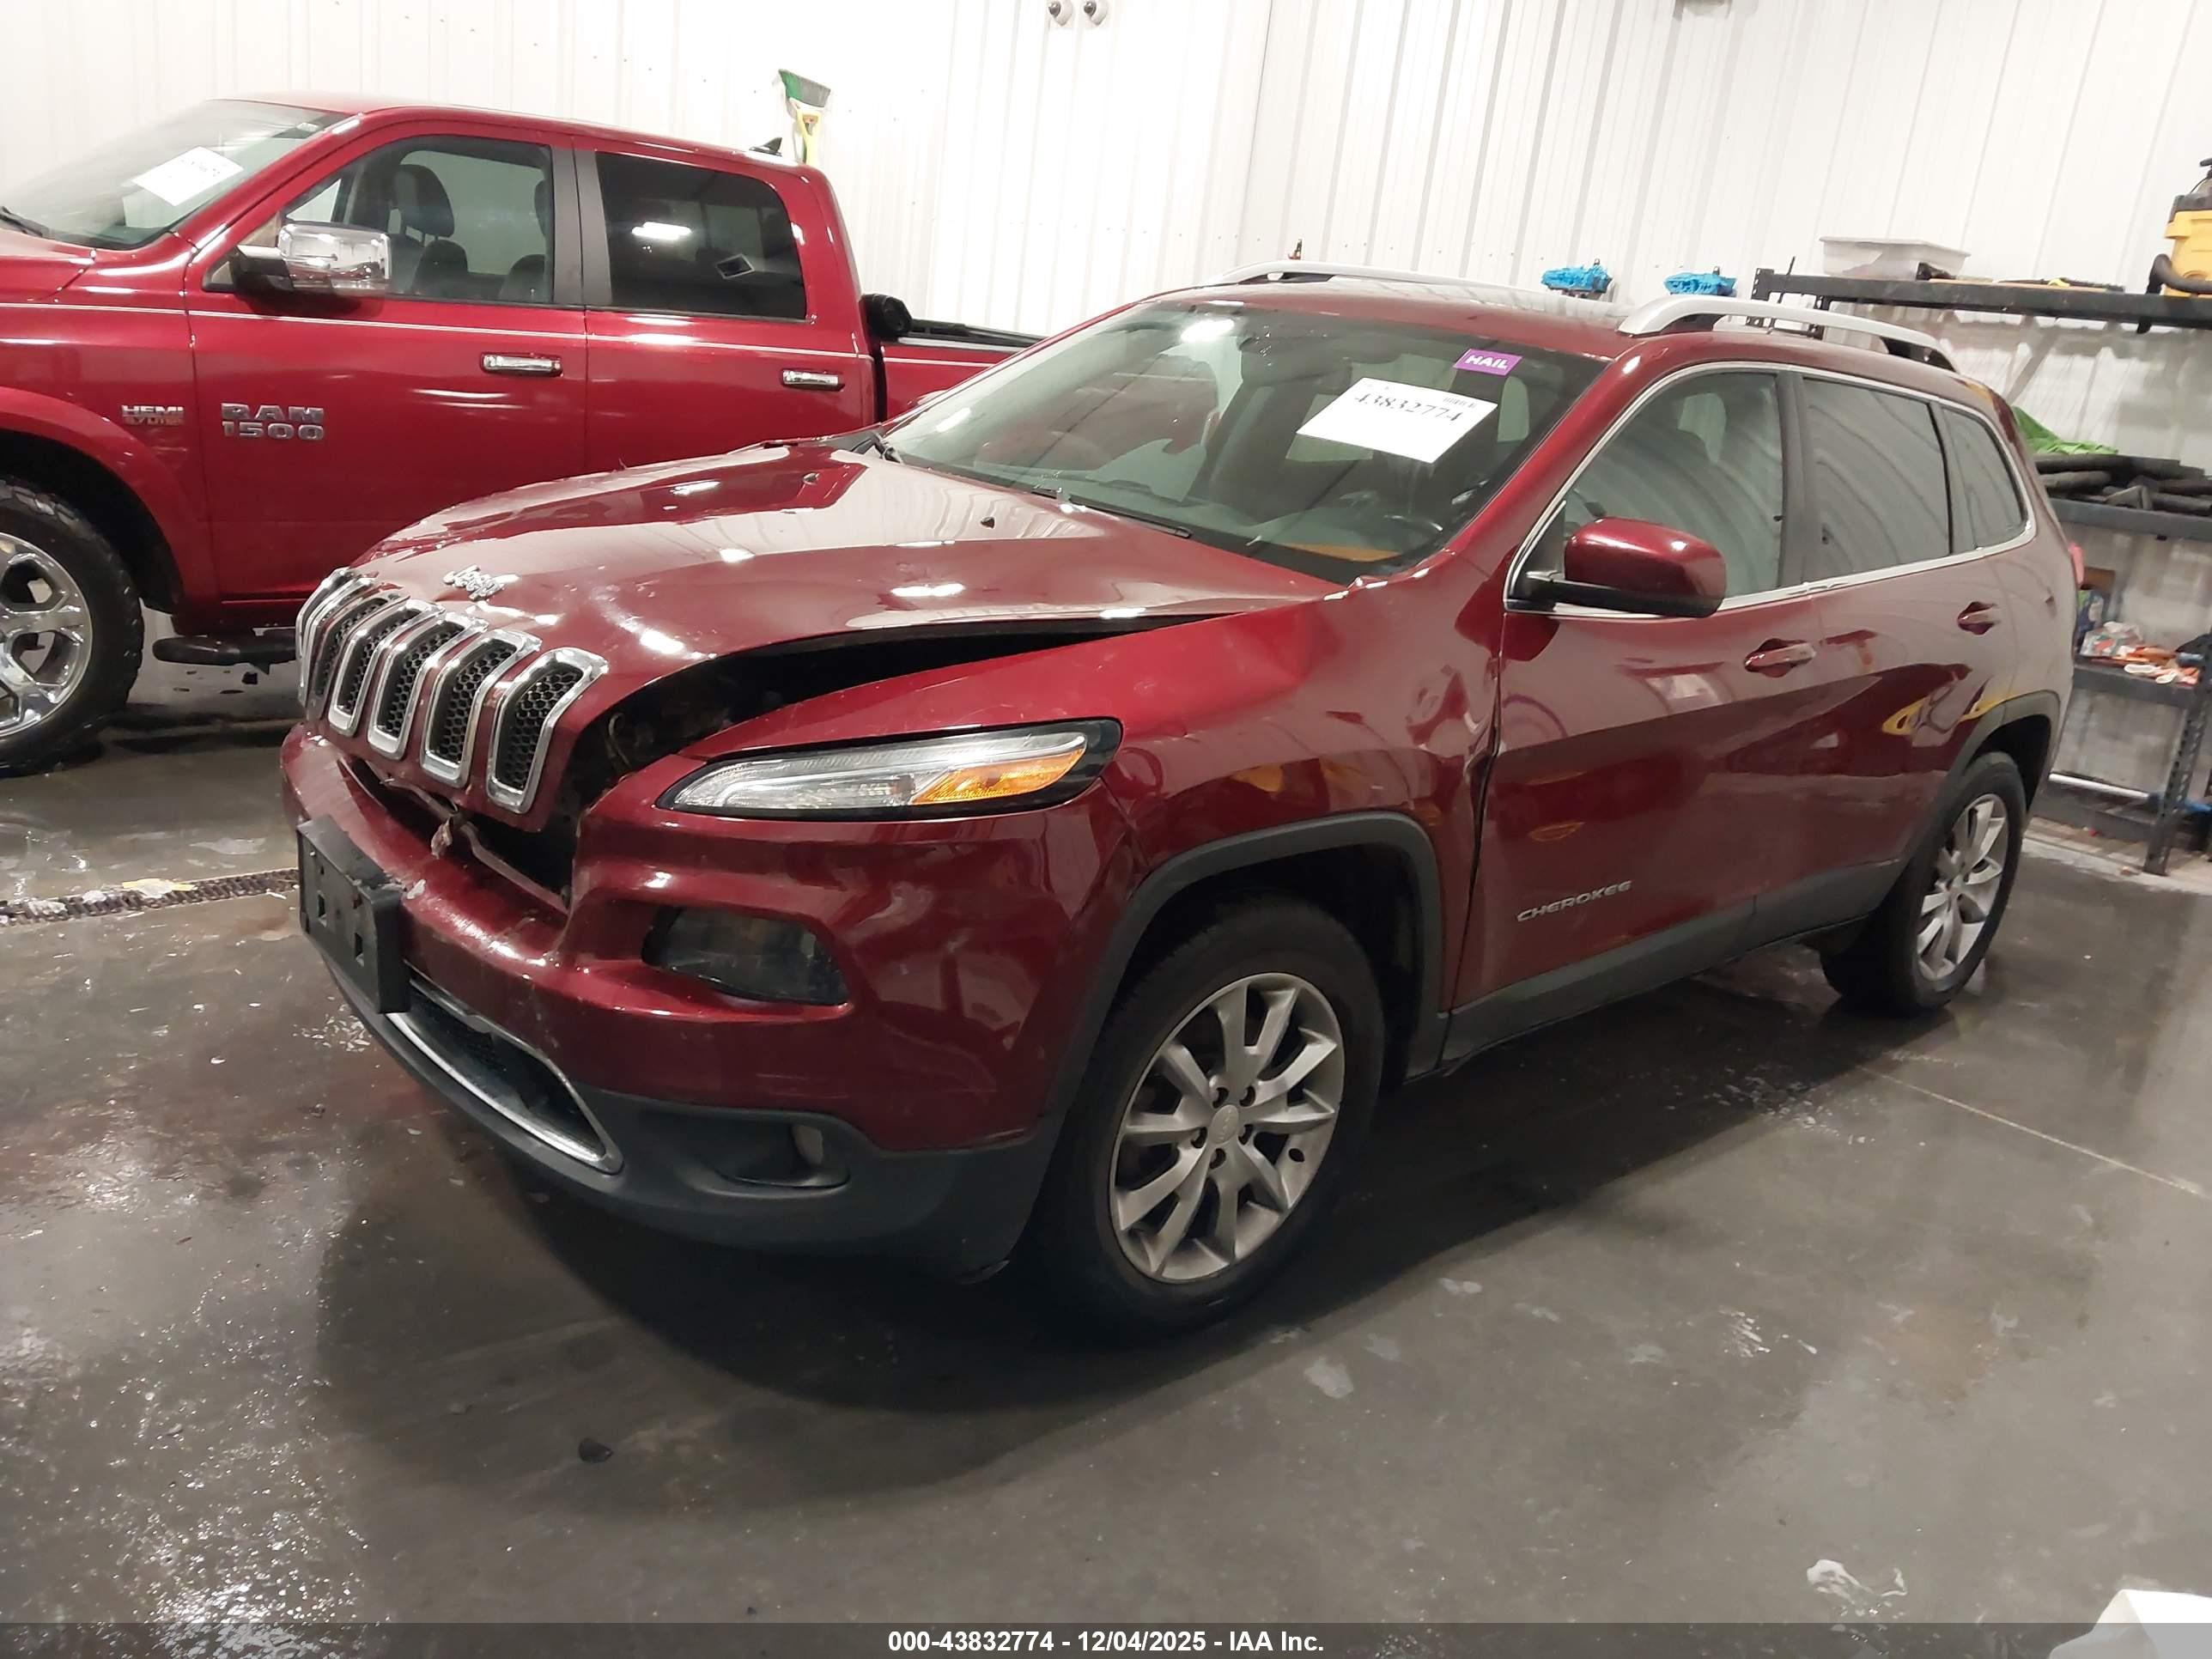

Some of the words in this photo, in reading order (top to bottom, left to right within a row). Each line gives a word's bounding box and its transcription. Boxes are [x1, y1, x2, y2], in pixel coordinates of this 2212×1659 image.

[1464, 355, 1509, 370] HAIL
[121, 404, 185, 417] HEMI
[221, 403, 324, 422] RAM
[1354, 392, 1463, 422] 43832774
[222, 421, 324, 441] 1500
[1516, 879, 1632, 922] CHEROKEE
